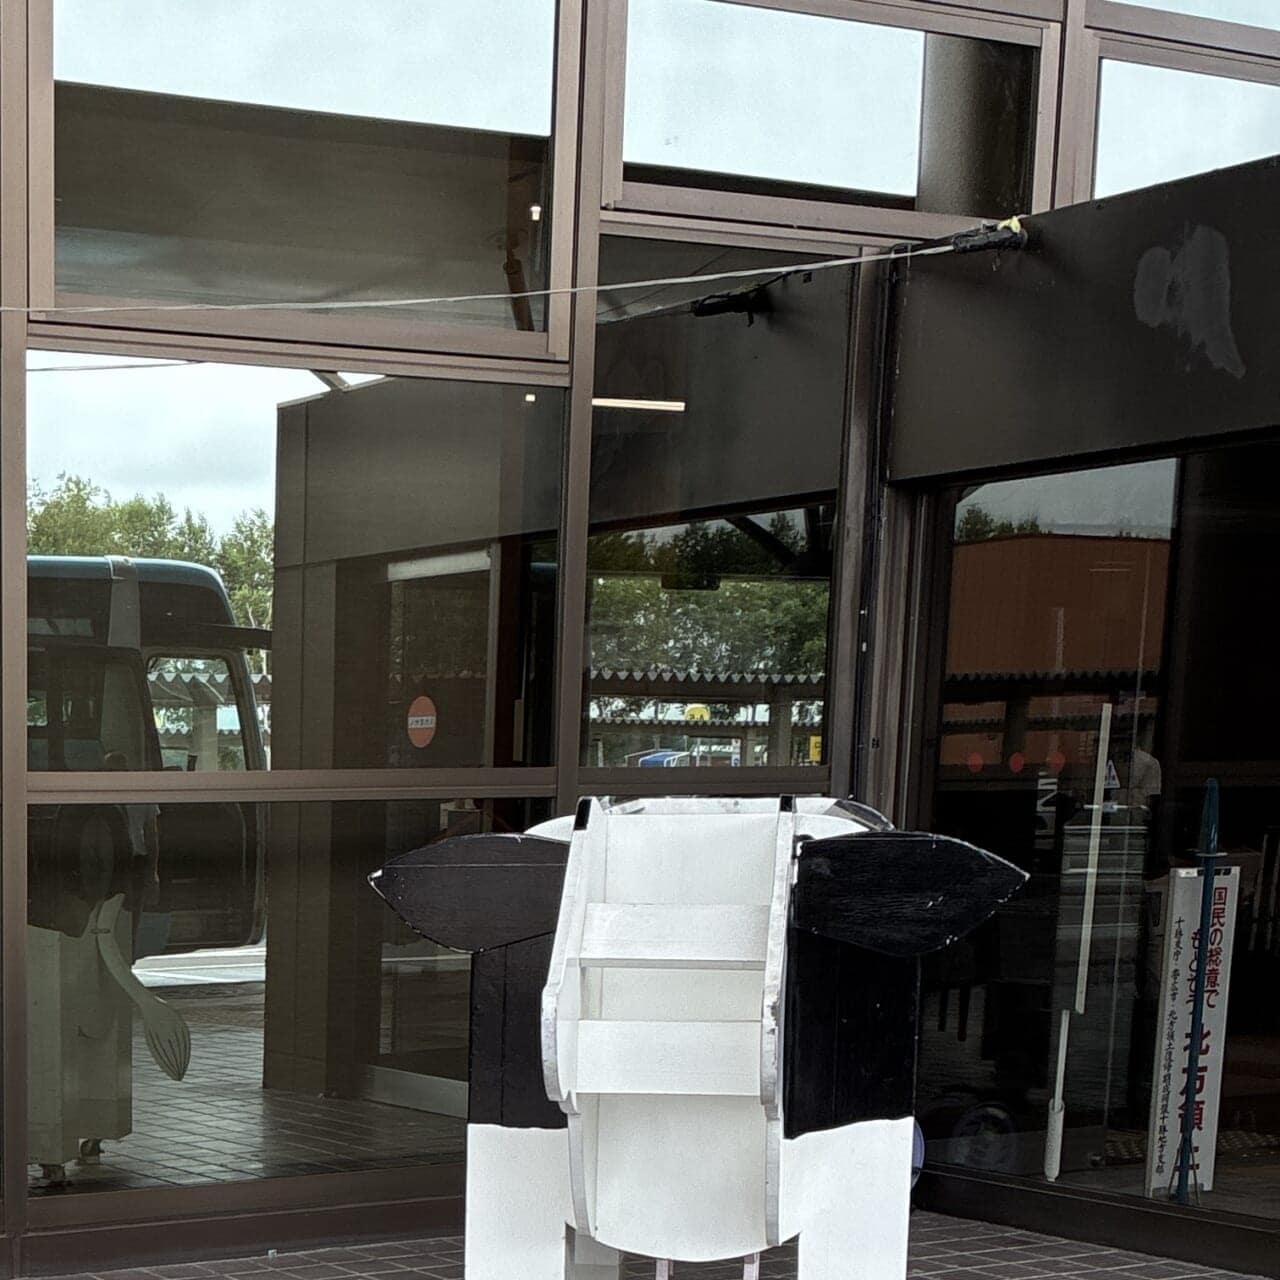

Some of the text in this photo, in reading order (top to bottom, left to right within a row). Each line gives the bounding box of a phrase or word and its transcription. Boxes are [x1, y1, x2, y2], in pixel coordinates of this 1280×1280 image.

[1204, 887, 1228, 1009] 国民の総意で
